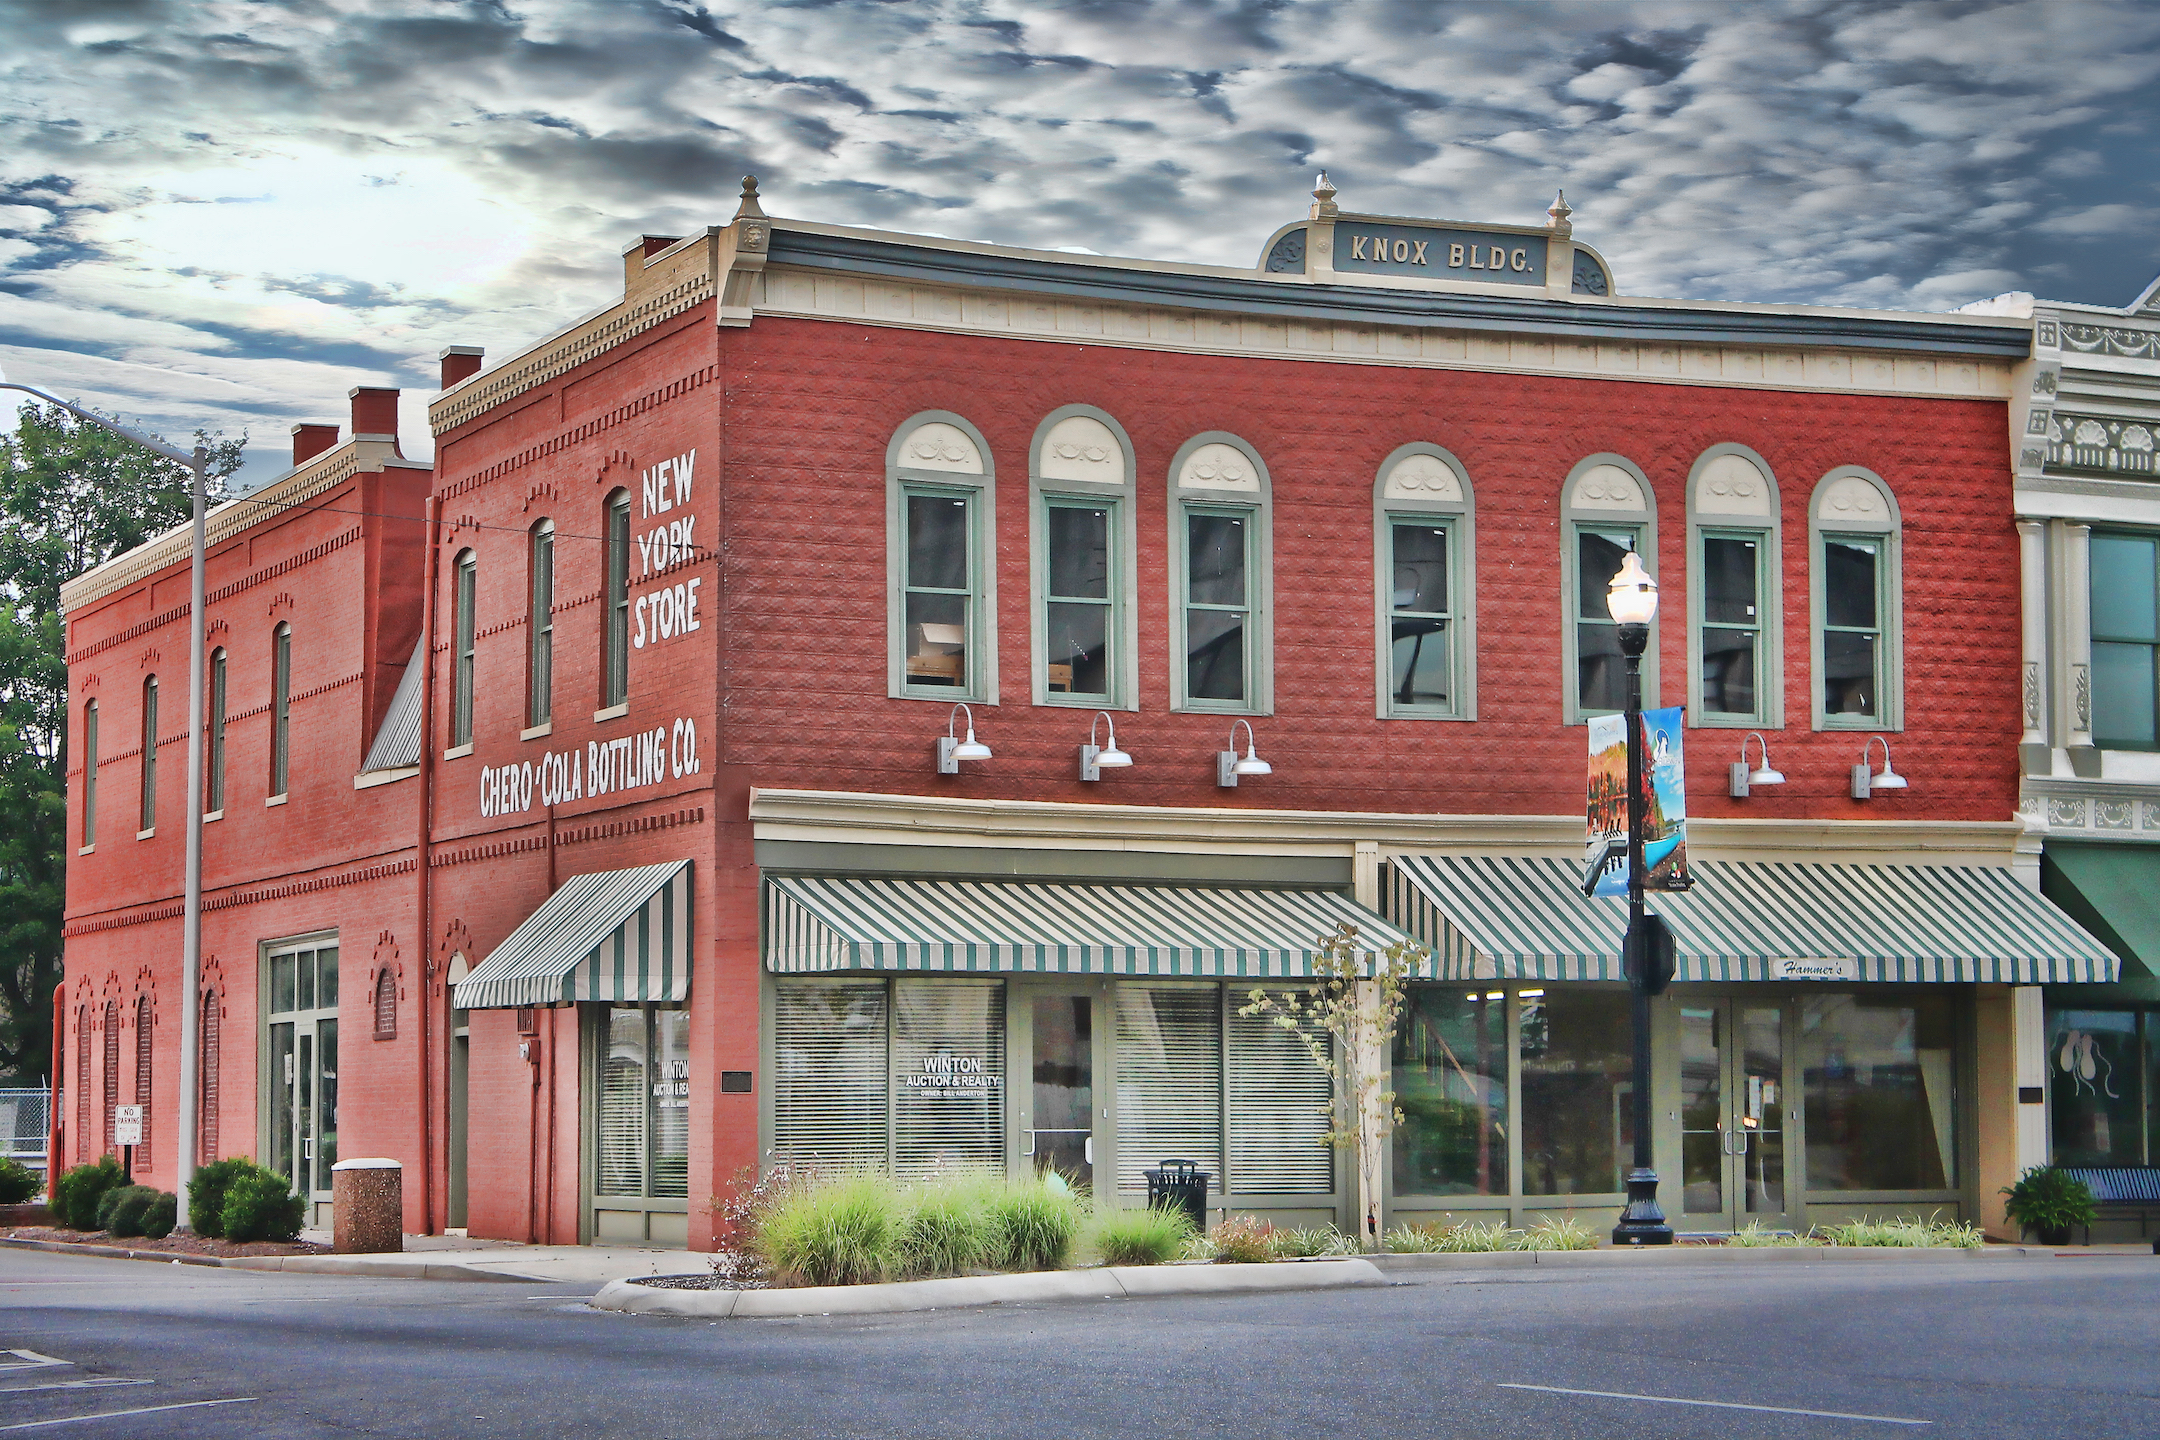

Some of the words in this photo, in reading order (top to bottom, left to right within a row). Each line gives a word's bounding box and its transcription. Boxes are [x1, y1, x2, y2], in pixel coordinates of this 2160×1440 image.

[1352, 235, 1429, 265] KNOX
[1448, 243, 1534, 272] BLDG.
[642, 447, 696, 520] NEW
[637, 513, 696, 576] YORK
[633, 576, 702, 649] STORE
[587, 726, 666, 798] BOTTLING
[671, 717, 700, 780] CO.
[1783, 960, 1842, 975] Hammer's
[661, 1060, 689, 1079] WINTON
[923, 1057, 981, 1073] WINTON
[652, 1083, 674, 1097] AUCTION
[905, 1075, 950, 1087] AUCTION
[951, 1075, 960, 1087] &
[961, 1075, 999, 1087] REALTY
[118, 1116, 140, 1124] PARKING
